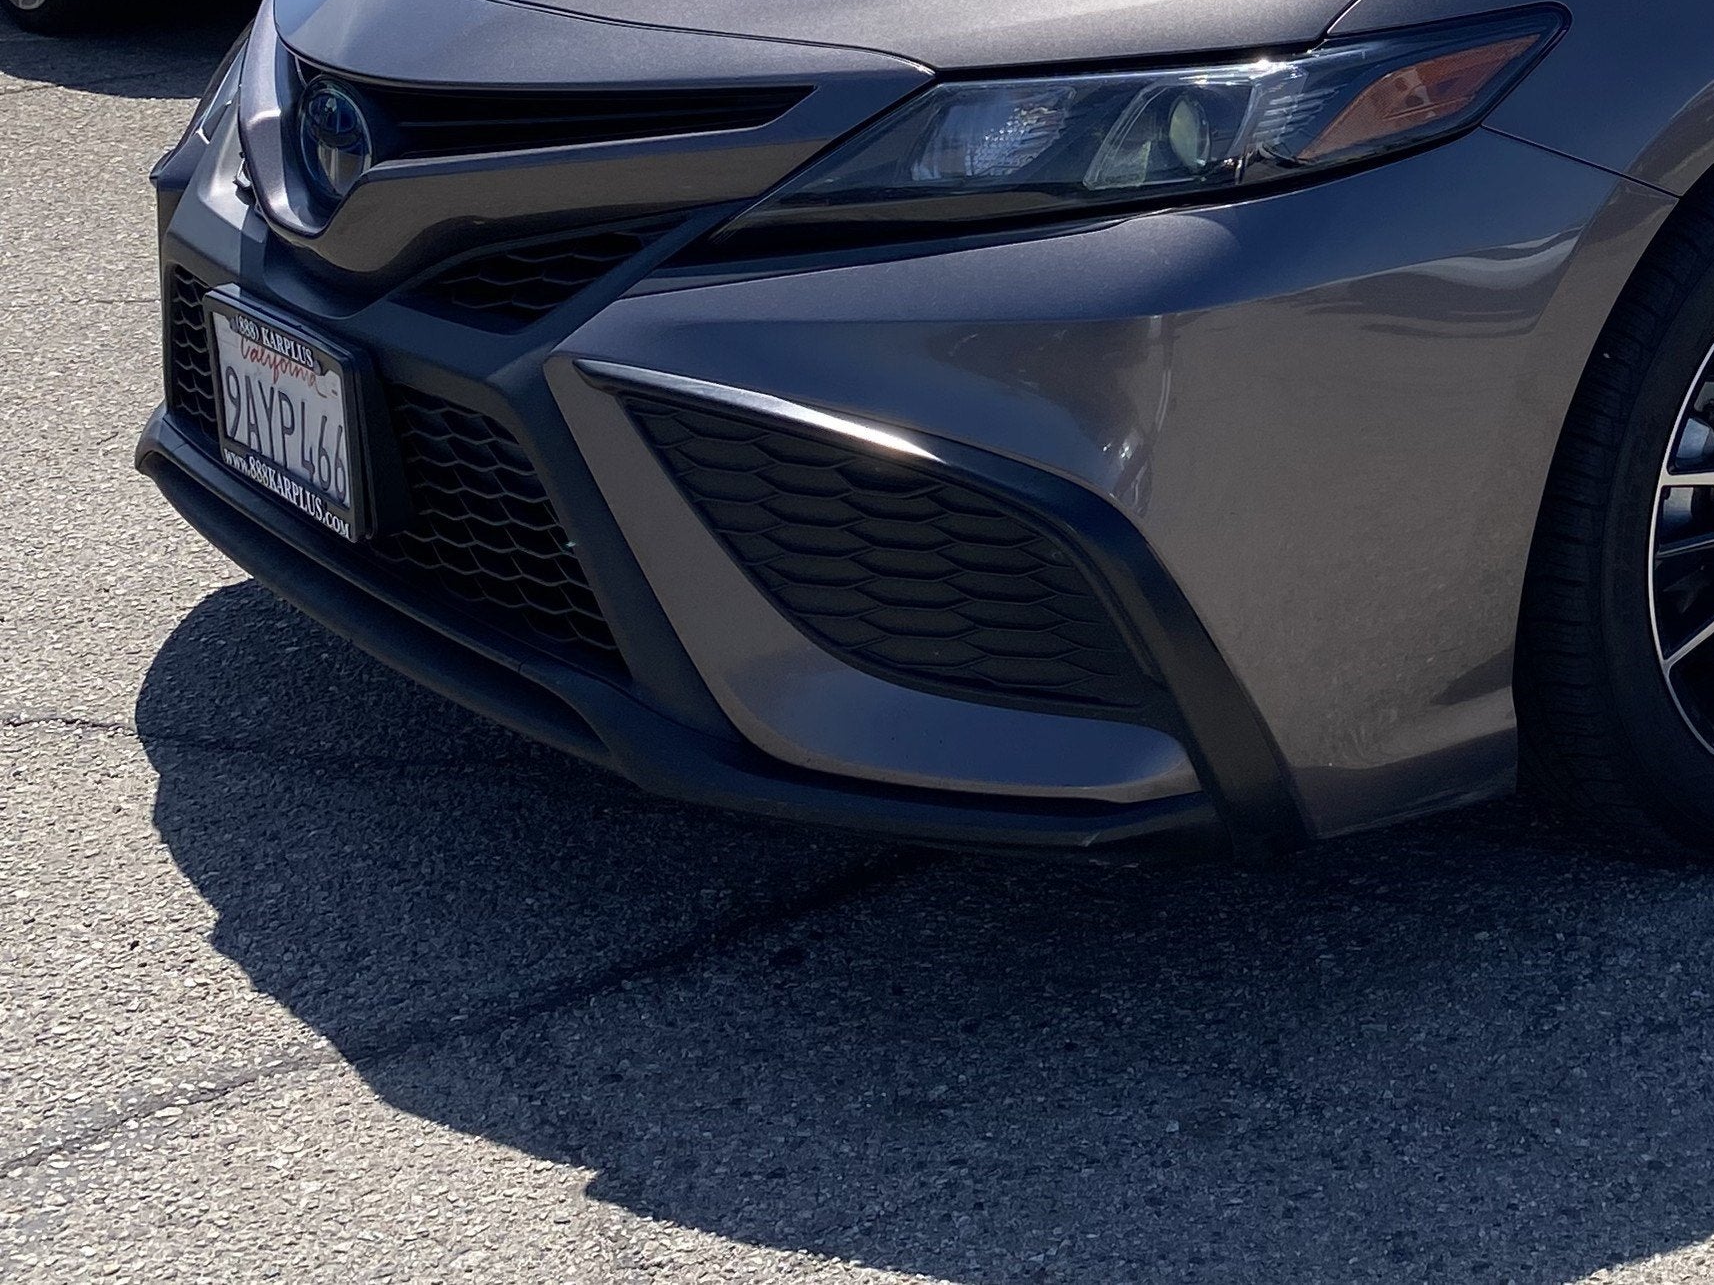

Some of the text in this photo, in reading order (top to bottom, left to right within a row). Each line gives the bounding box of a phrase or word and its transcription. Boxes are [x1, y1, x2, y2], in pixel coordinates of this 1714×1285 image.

[235, 315, 314, 368] (888) KARPLUS
[240, 335, 321, 390] California
[225, 365, 347, 503] 9AYP466
